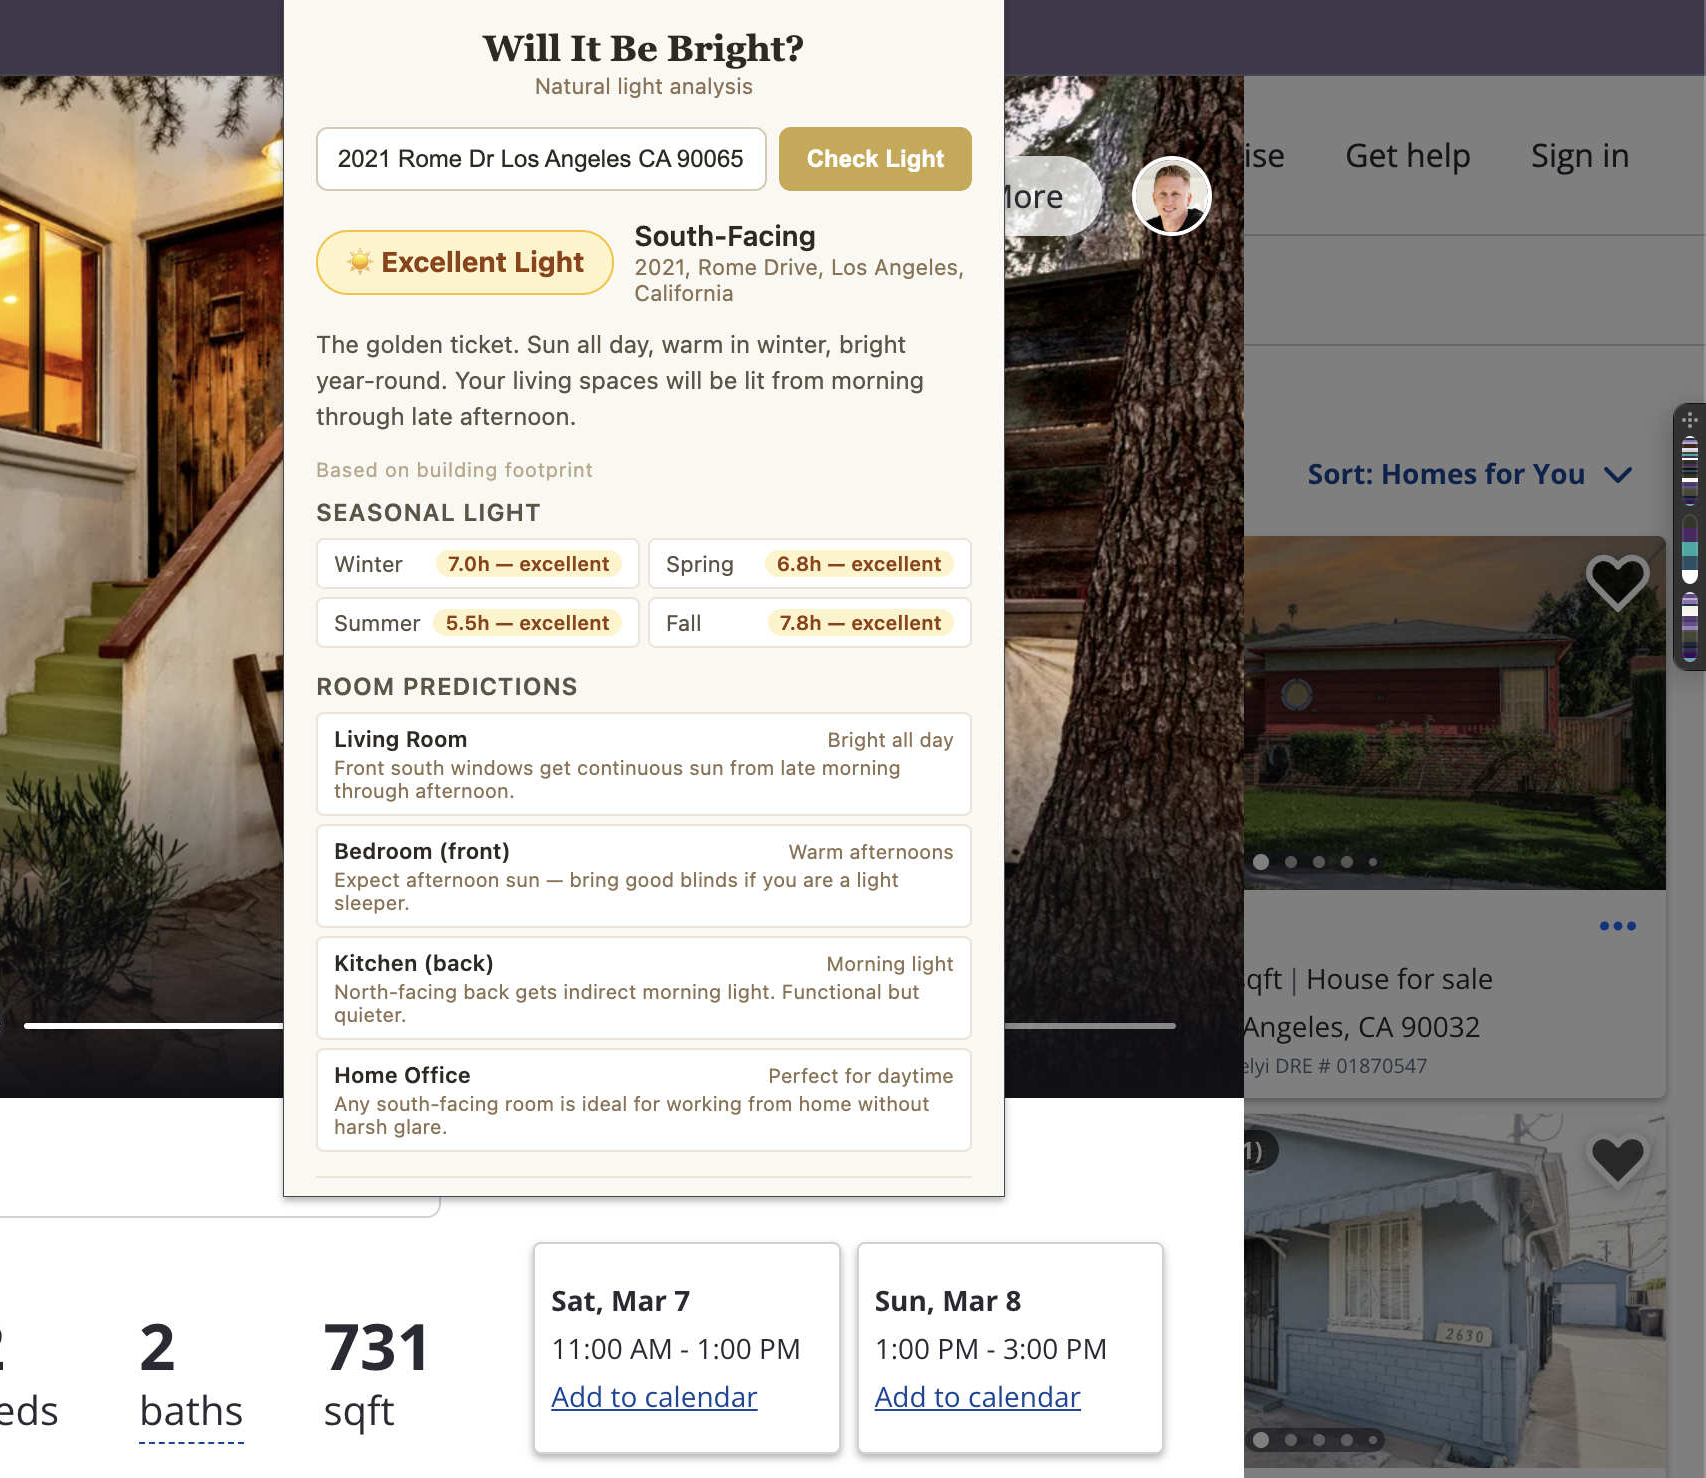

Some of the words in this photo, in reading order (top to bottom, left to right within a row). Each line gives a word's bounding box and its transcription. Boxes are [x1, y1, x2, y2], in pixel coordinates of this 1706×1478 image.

[481, 32, 562, 63] Will
[570, 34, 602, 63] It
[610, 34, 658, 63] Be
[667, 32, 804, 70] Bright?
[535, 76, 610, 95] Natural
[618, 76, 663, 99] light
[669, 76, 753, 99] analysis
[337, 148, 388, 169] 2021
[398, 148, 462, 169] Rome
[469, 148, 496, 168] Dr
[501, 148, 540, 169] Los
[543, 148, 632, 173] Angeles
[638, 148, 673, 169] CA
[676, 148, 744, 169] 90065
[806, 148, 880, 169] Check
[886, 148, 945, 173] Light
[1346, 142, 1399, 169] Get
[1407, 141, 1471, 176] help
[1531, 142, 1593, 176] Sign
[1603, 142, 1629, 168] in
[1005, 184, 1063, 209] ore
[635, 223, 816, 252] South-Facing
[382, 250, 507, 274] Excellent
[515, 249, 585, 279] Light
[635, 258, 690, 280] 2021,
[698, 258, 757, 276] Rome
[764, 257, 824, 280] Drive,
[832, 258, 868, 276] Los
[873, 257, 964, 280] Angeles,
[634, 283, 734, 303] California
[316, 461, 378, 478] Based
[385, 465, 409, 478] on
[417, 461, 497, 482] building
[504, 461, 593, 482] footprint
[1308, 463, 1373, 486] Sort:
[1382, 463, 1478, 486] Homes
[1484, 461, 1526, 485] for
[1532, 463, 1585, 485] You
[316, 502, 455, 523] SEASONAL
[464, 502, 541, 523] LIGHT
[334, 554, 404, 573] Winter
[447, 555, 490, 573] 7.0h
[519, 555, 611, 573] excellent
[666, 554, 734, 577] Spring
[334, 614, 421, 633] Summer
[667, 613, 701, 632] Fall
[317, 676, 394, 697] ROOM
[403, 676, 577, 697] PREDICTIONS
[335, 729, 399, 752] Living
[406, 730, 467, 748] Room
[335, 841, 432, 860] Bedroom
[440, 841, 510, 864] (front)
[335, 953, 417, 972] Kitchen
[425, 953, 493, 976] (back)
[1244, 967, 1282, 996] qft
[1307, 968, 1390, 991] House
[1396, 966, 1435, 991] for
[1442, 966, 1493, 991] sale
[1244, 1014, 1350, 1045] Angeles,
[1358, 1015, 1395, 1039] CA
[1401, 1015, 1481, 1039] 90032
[335, 1066, 398, 1084] Home
[404, 1065, 471, 1085] Office
[1276, 1057, 1313, 1074] DRE
[1317, 1057, 1332, 1074] #
[1336, 1057, 1428, 1074] 01870547
[551, 1289, 603, 1316] Sat,
[612, 1290, 668, 1313] Mar
[674, 1290, 691, 1312] 7
[875, 1290, 934, 1316] Sun,
[943, 1290, 999, 1313] Mar
[1005, 1290, 1022, 1313] 8
[140, 1322, 175, 1371] 2
[324, 1322, 424, 1372] 731
[1445, 1328, 1483, 1343] 2630
[552, 1337, 623, 1361] 11:00
[629, 1338, 674, 1361] AM
[698, 1337, 753, 1361] 1:00
[760, 1338, 800, 1360] PM
[876, 1337, 930, 1361] 1:00
[939, 1338, 978, 1360] PM
[1003, 1337, 1058, 1361] 3:00
[1067, 1338, 1106, 1360] PM
[550, 1384, 602, 1408] Add
[610, 1387, 637, 1409] to
[645, 1384, 758, 1409] calendar
[874, 1384, 926, 1408] Add
[933, 1387, 960, 1408] to
[968, 1384, 1082, 1409] calendar
[141, 1393, 243, 1427] baths
[324, 1393, 395, 1436] sqft
